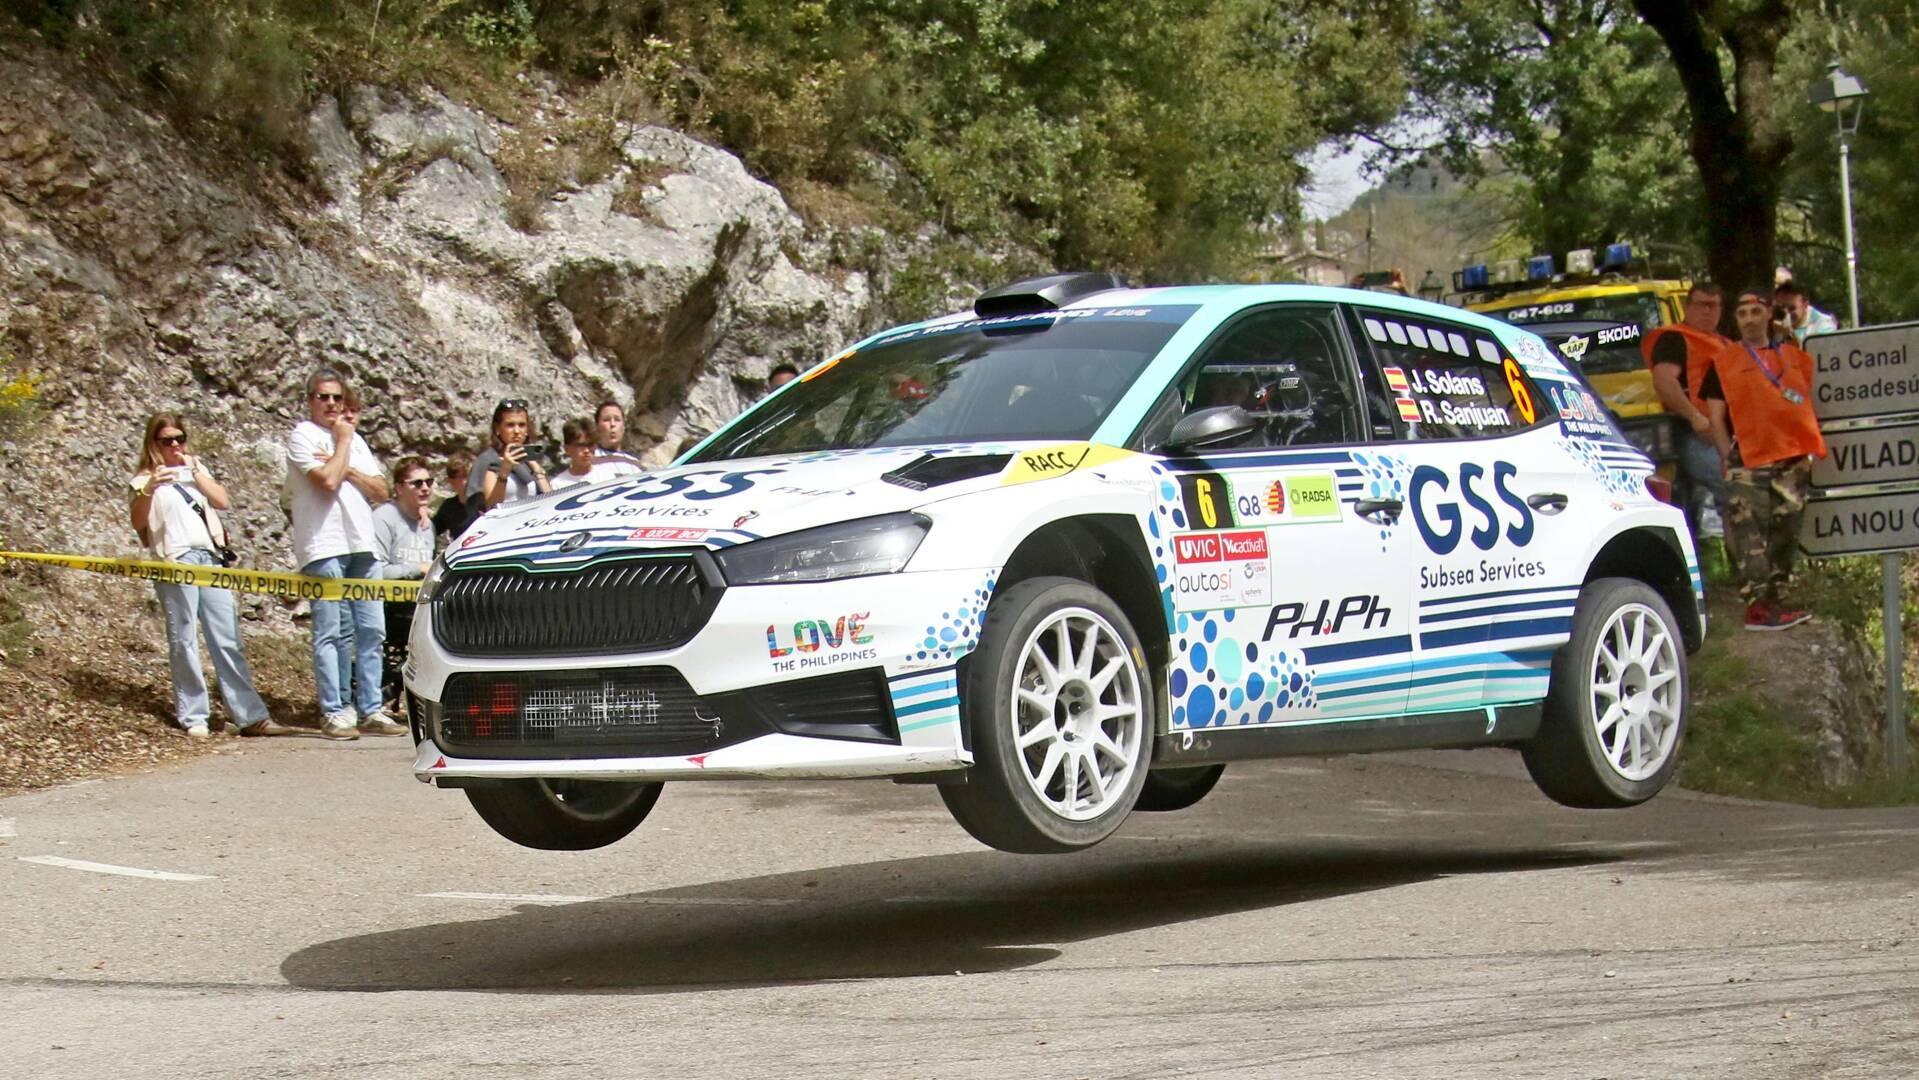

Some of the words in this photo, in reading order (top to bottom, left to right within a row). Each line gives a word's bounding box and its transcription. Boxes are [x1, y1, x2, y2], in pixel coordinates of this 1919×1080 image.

[1508, 303, 1575, 320] 047-602
[1817, 353, 1840, 372] La
[1848, 345, 1907, 369] Canal
[1411, 369, 1428, 394] J.
[1425, 370, 1485, 396] Solans
[1503, 358, 1535, 425] 6
[1818, 373, 1919, 403] Casadesú
[1420, 400, 1443, 425] R.
[1440, 400, 1511, 430] Sanjuan
[1024, 451, 1074, 472] RACC
[1832, 440, 1919, 471] VILAD
[555, 469, 788, 511] GSS
[1196, 478, 1218, 529] 6
[1301, 490, 1332, 502] RADSA
[515, 505, 602, 531] Subsea
[606, 503, 713, 519] Services
[1238, 495, 1261, 517] Q8
[1409, 460, 1535, 556] GSS
[1815, 515, 1844, 538] LA
[1852, 509, 1903, 535] NOU
[1179, 538, 1217, 559] UVIC
[84, 561, 125, 577] ZONA
[129, 565, 196, 585] PUBLICO
[210, 572, 252, 591] ZONA
[256, 576, 324, 600] PUBLICO
[1420, 564, 1474, 589] Subsea
[1480, 556, 1546, 583] Services
[341, 584, 386, 601] ZONA
[766, 611, 875, 658] LOVE
[772, 660, 796, 673] THE
[800, 648, 878, 669] PHILIPPINES
